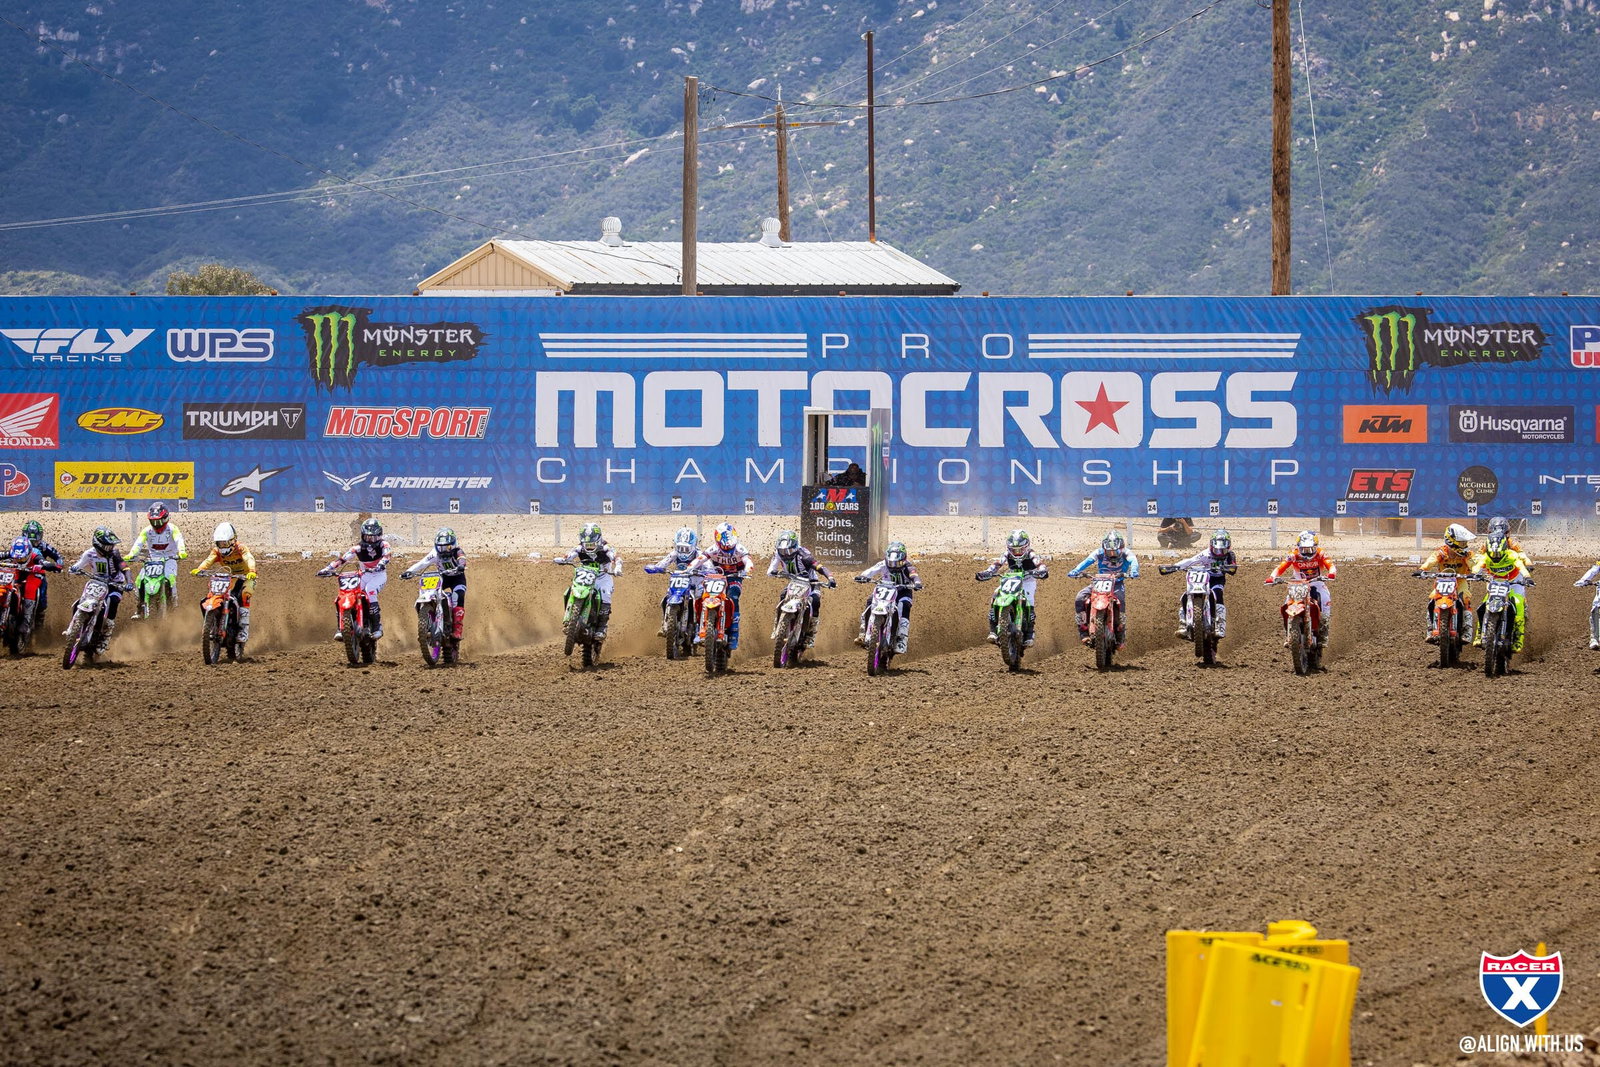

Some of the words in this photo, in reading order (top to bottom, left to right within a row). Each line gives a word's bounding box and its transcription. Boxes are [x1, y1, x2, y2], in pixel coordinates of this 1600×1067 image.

[36, 328, 156, 354] FLY
[363, 325, 476, 347] MONSTER
[1423, 325, 1538, 347] MONSTER
[168, 329, 273, 361] WPS
[822, 333, 1014, 359] PRO
[535, 371, 1299, 448] MOTOCROSS
[79, 411, 163, 428] FMF
[186, 411, 278, 427] TRIUMPH
[1358, 415, 1413, 433] KTM
[1480, 418, 1565, 433] Husqvarna
[0, 437, 55, 446] HONDA
[80, 473, 189, 485] DUNLOP
[369, 476, 493, 489] LANDMASTER
[1351, 472, 1412, 492] ETS
[77, 486, 144, 494] MOTORCYCLE
[149, 486, 180, 494] TIRES
[812, 488, 857, 502] AMA
[44, 500, 49, 508] 8
[816, 517, 854, 529] Rights.
[816, 532, 854, 544] Riding.
[815, 547, 855, 558] Racing.
[146, 565, 163, 576] 378
[340, 577, 360, 589] 30
[670, 577, 690, 588] 705
[704, 580, 725, 593] 16
[1002, 580, 1021, 591] 47
[1093, 580, 1112, 592] 48
[1436, 581, 1455, 593] 473
